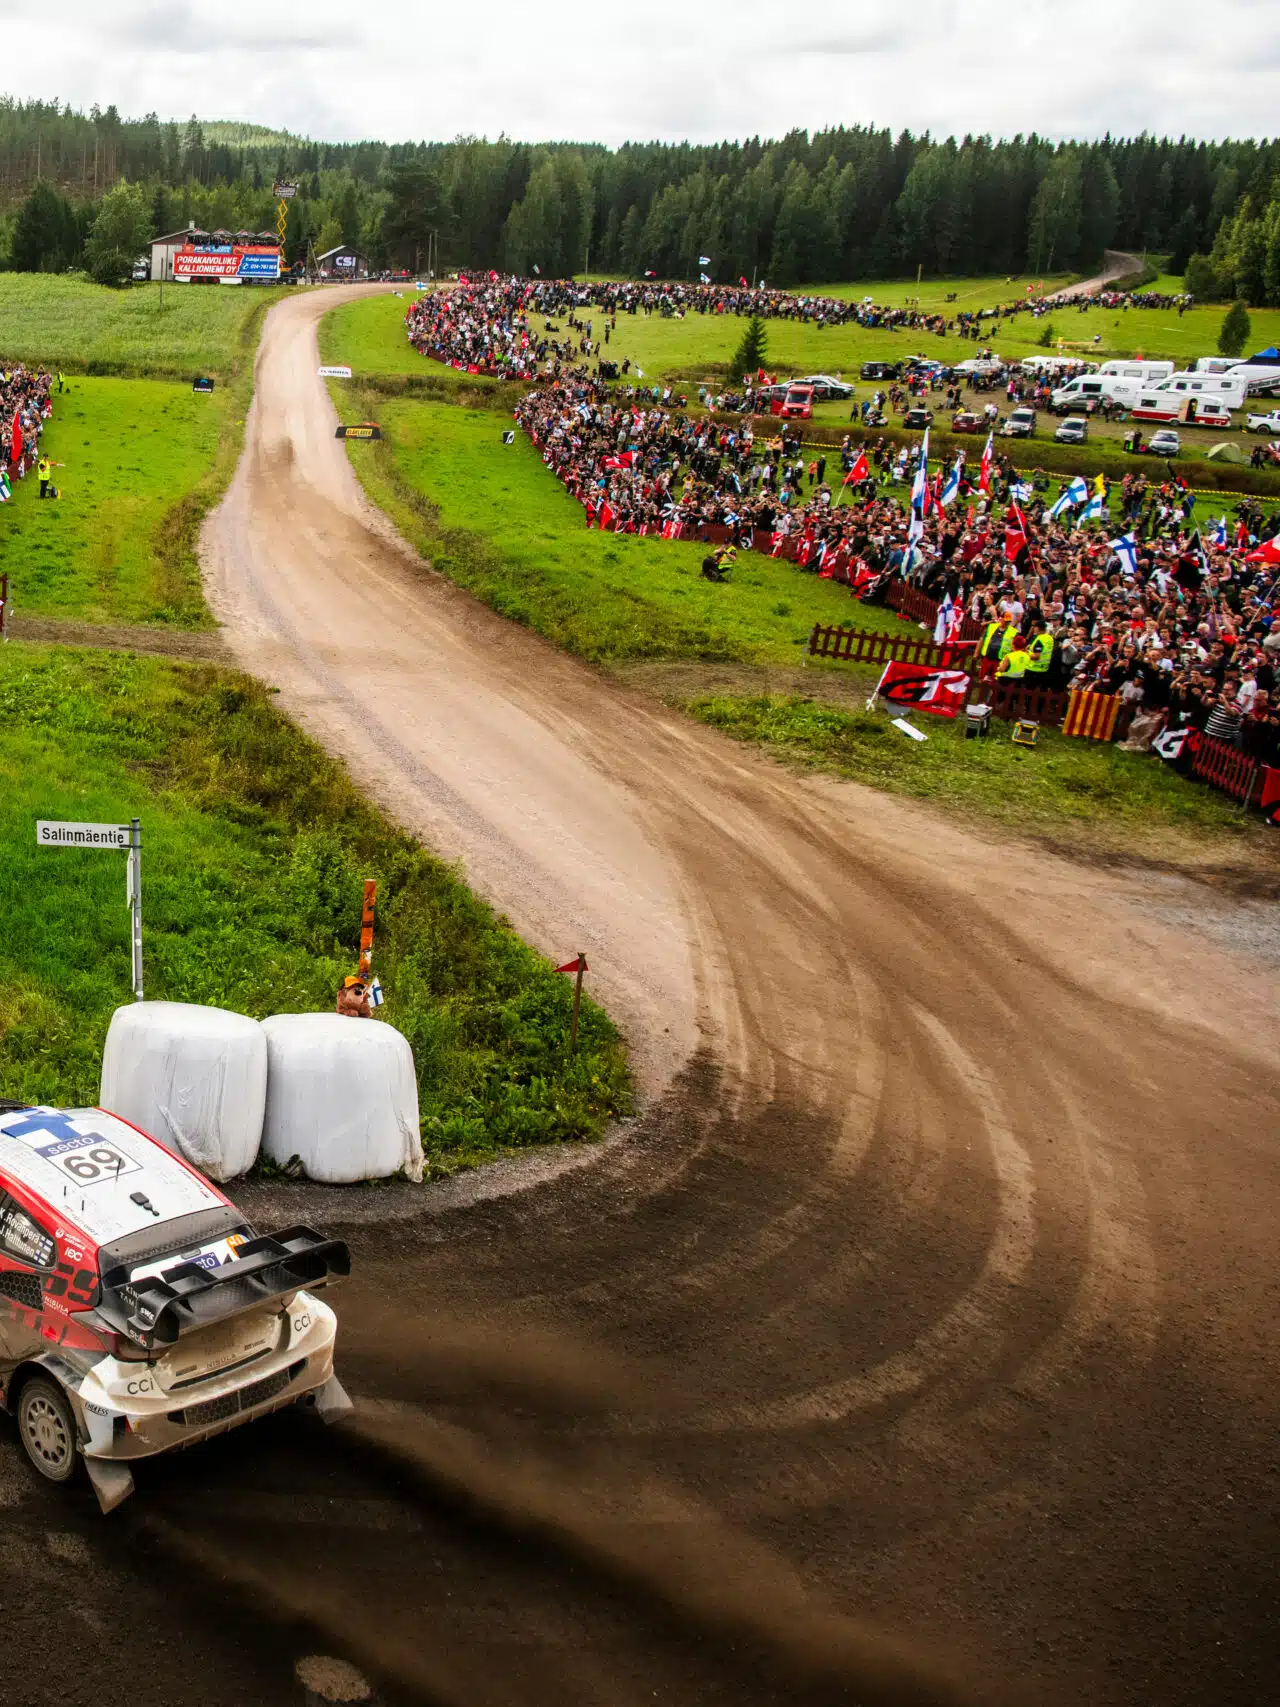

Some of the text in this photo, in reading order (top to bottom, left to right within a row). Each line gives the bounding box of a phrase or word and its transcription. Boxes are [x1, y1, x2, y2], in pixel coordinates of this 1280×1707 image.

[177, 256, 237, 264] PORAKAIVOLIIKE
[335, 256, 356, 267] CSI
[178, 265, 225, 273] KALLIONIEMI
[42, 827, 124, 844] Salinmäentie
[47, 1135, 95, 1156] secto
[63, 1148, 126, 1179] 69
[84, 1402, 109, 1416] ENDLESS
